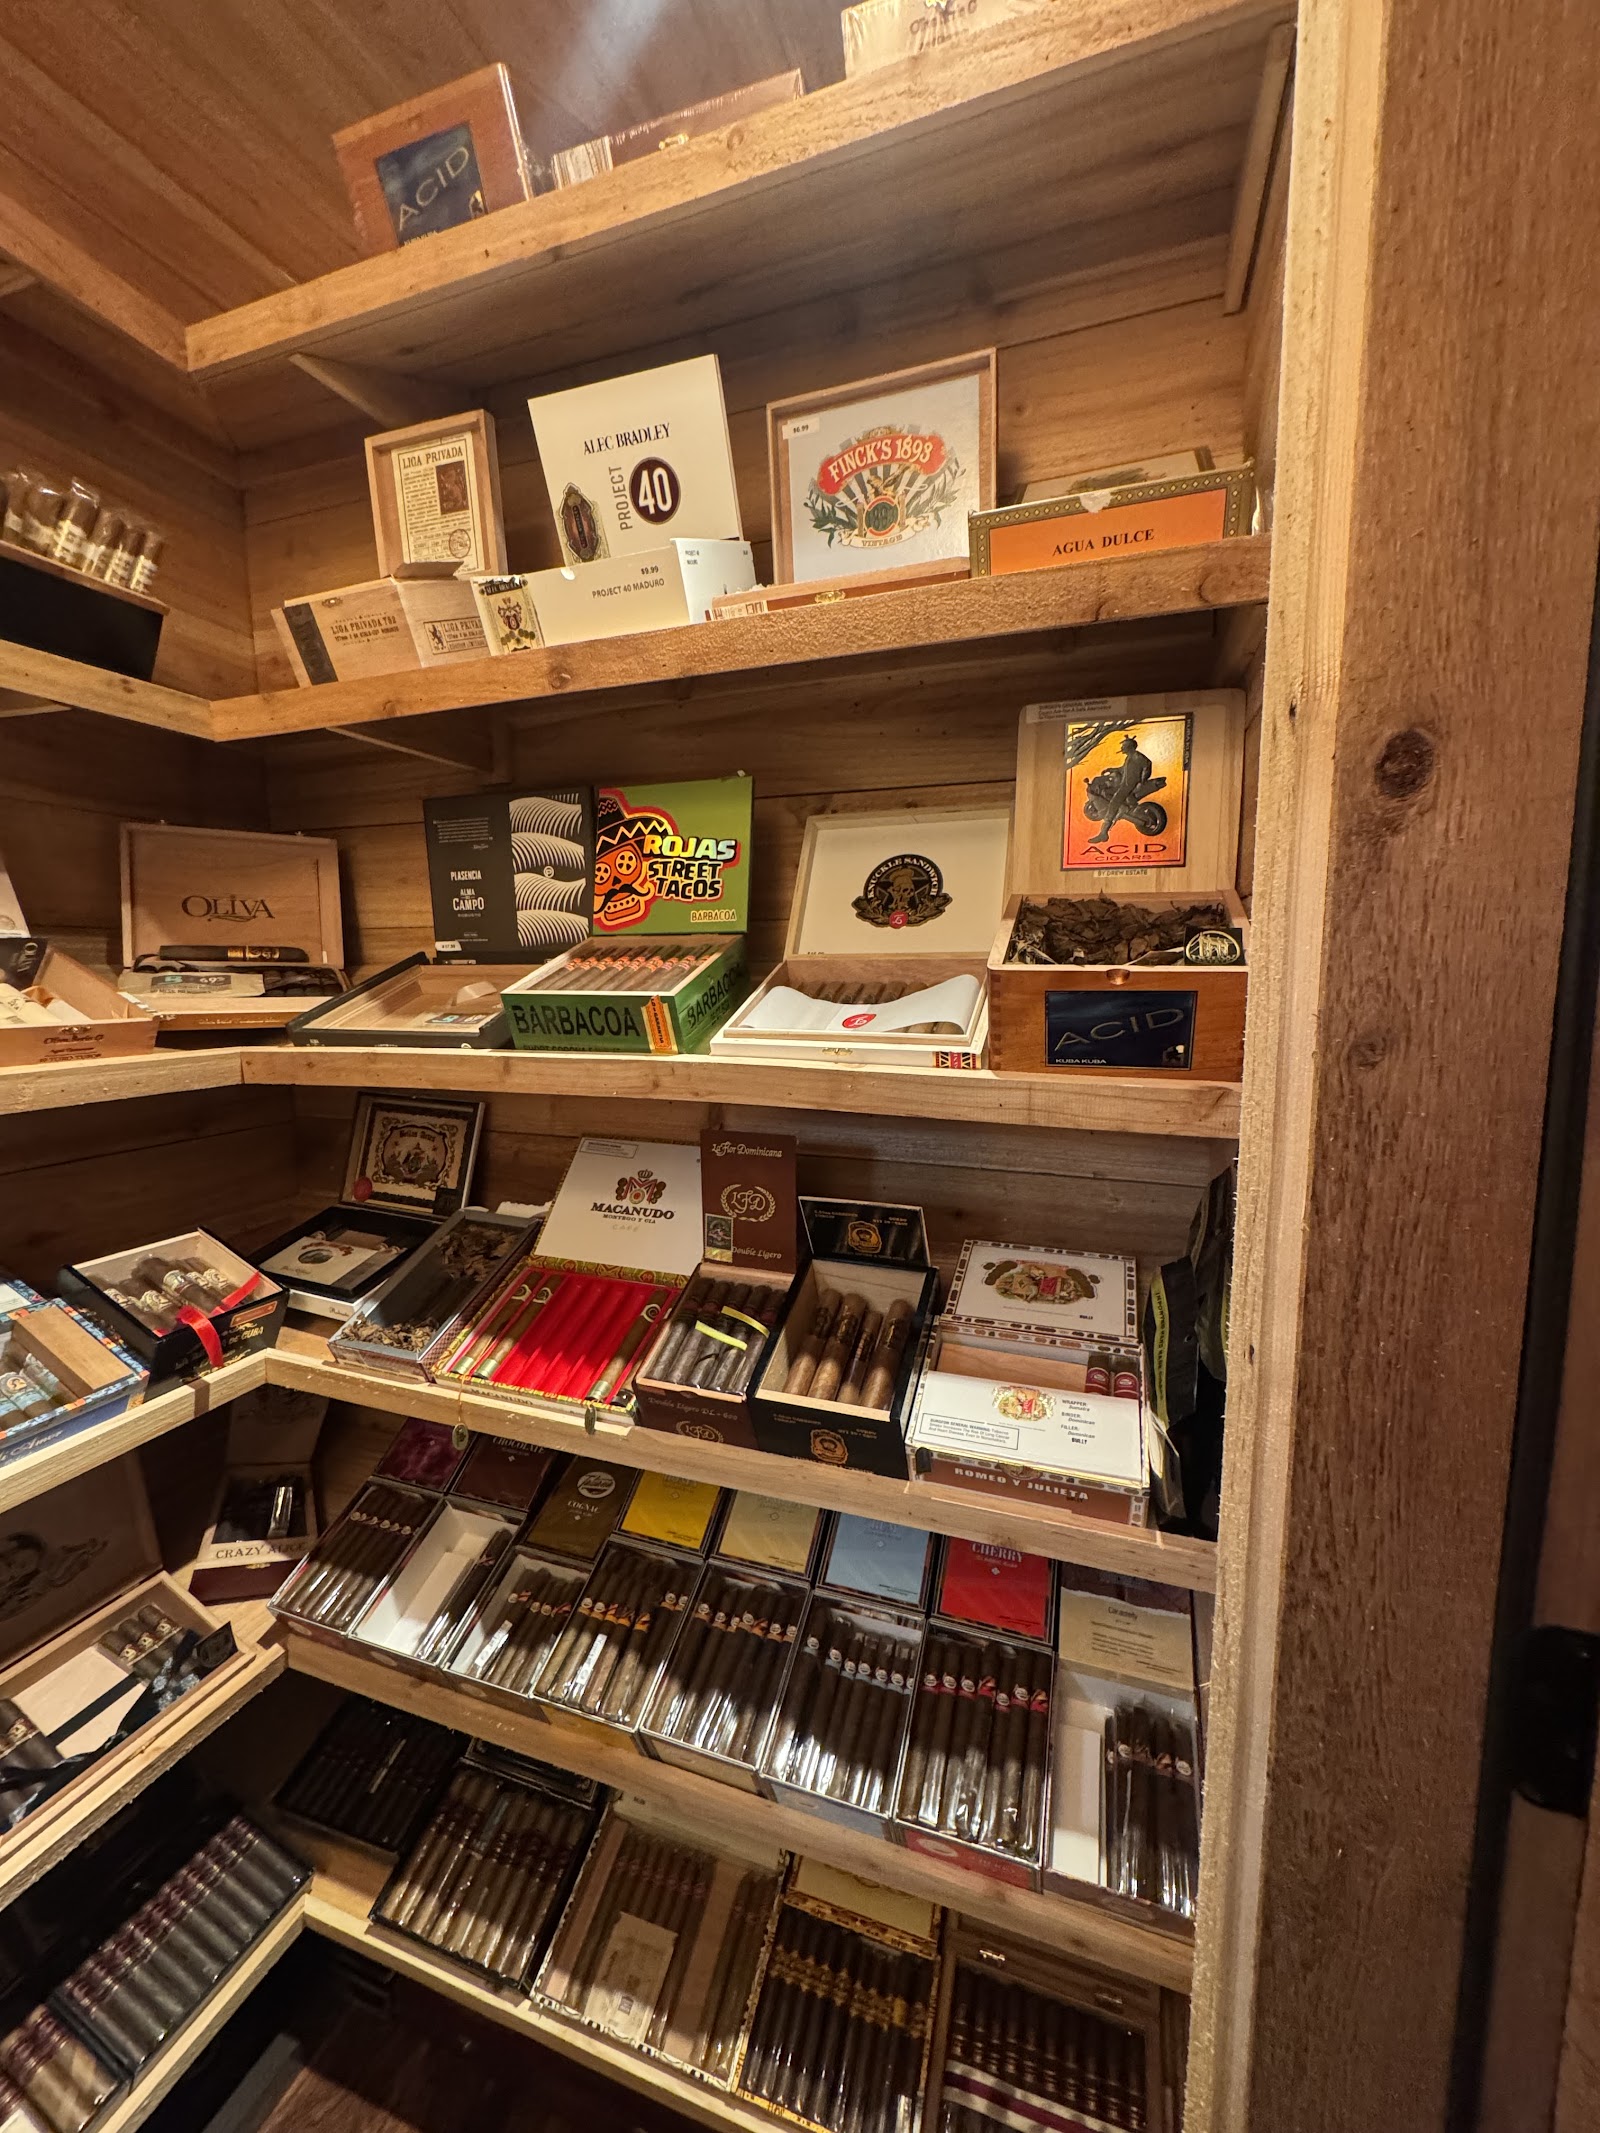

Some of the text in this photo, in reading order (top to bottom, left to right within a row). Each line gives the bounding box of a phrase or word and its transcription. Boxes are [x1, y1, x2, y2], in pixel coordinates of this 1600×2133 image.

[400, 147, 469, 232] ACID
[583, 422, 670, 456] ALEC BRADLEY
[402, 445, 463, 470] LIGA PRIVADA
[828, 434, 934, 484] FINCK'S 1893
[608, 466, 634, 531] PROJECT
[638, 466, 673, 515] 40
[1052, 528, 1155, 557] AGUA DULCE
[640, 565, 659, 576] $9.99
[592, 577, 665, 599] PROJECT 40 MADURO
[643, 834, 737, 860] ROJAS
[1080, 843, 1167, 855] ACID
[1094, 854, 1152, 862] CIGARS
[450, 870, 482, 881] PLASENCIA
[647, 859, 722, 881] STREET
[867, 857, 939, 899] KNUCKLE SANDWICH
[460, 888, 475, 896] ALMA
[655, 877, 721, 900] TACOS
[181, 894, 275, 920] OLIVA
[452, 897, 485, 911] CAMPO
[691, 909, 737, 922] BARBACOA
[511, 1005, 641, 1037] BARBACOA
[1054, 1008, 1186, 1052] ACID
[736, 1143, 782, 1158] Dominicana
[590, 1201, 675, 1220] MACANUDO
[757, 1248, 782, 1260] Ligero
[954, 1466, 1089, 1501] ROMEO Y JULIETA
[567, 1500, 601, 1514] COGNAC
[215, 1544, 265, 1559] CRAZY
[970, 1542, 1024, 1563] CHERRY
